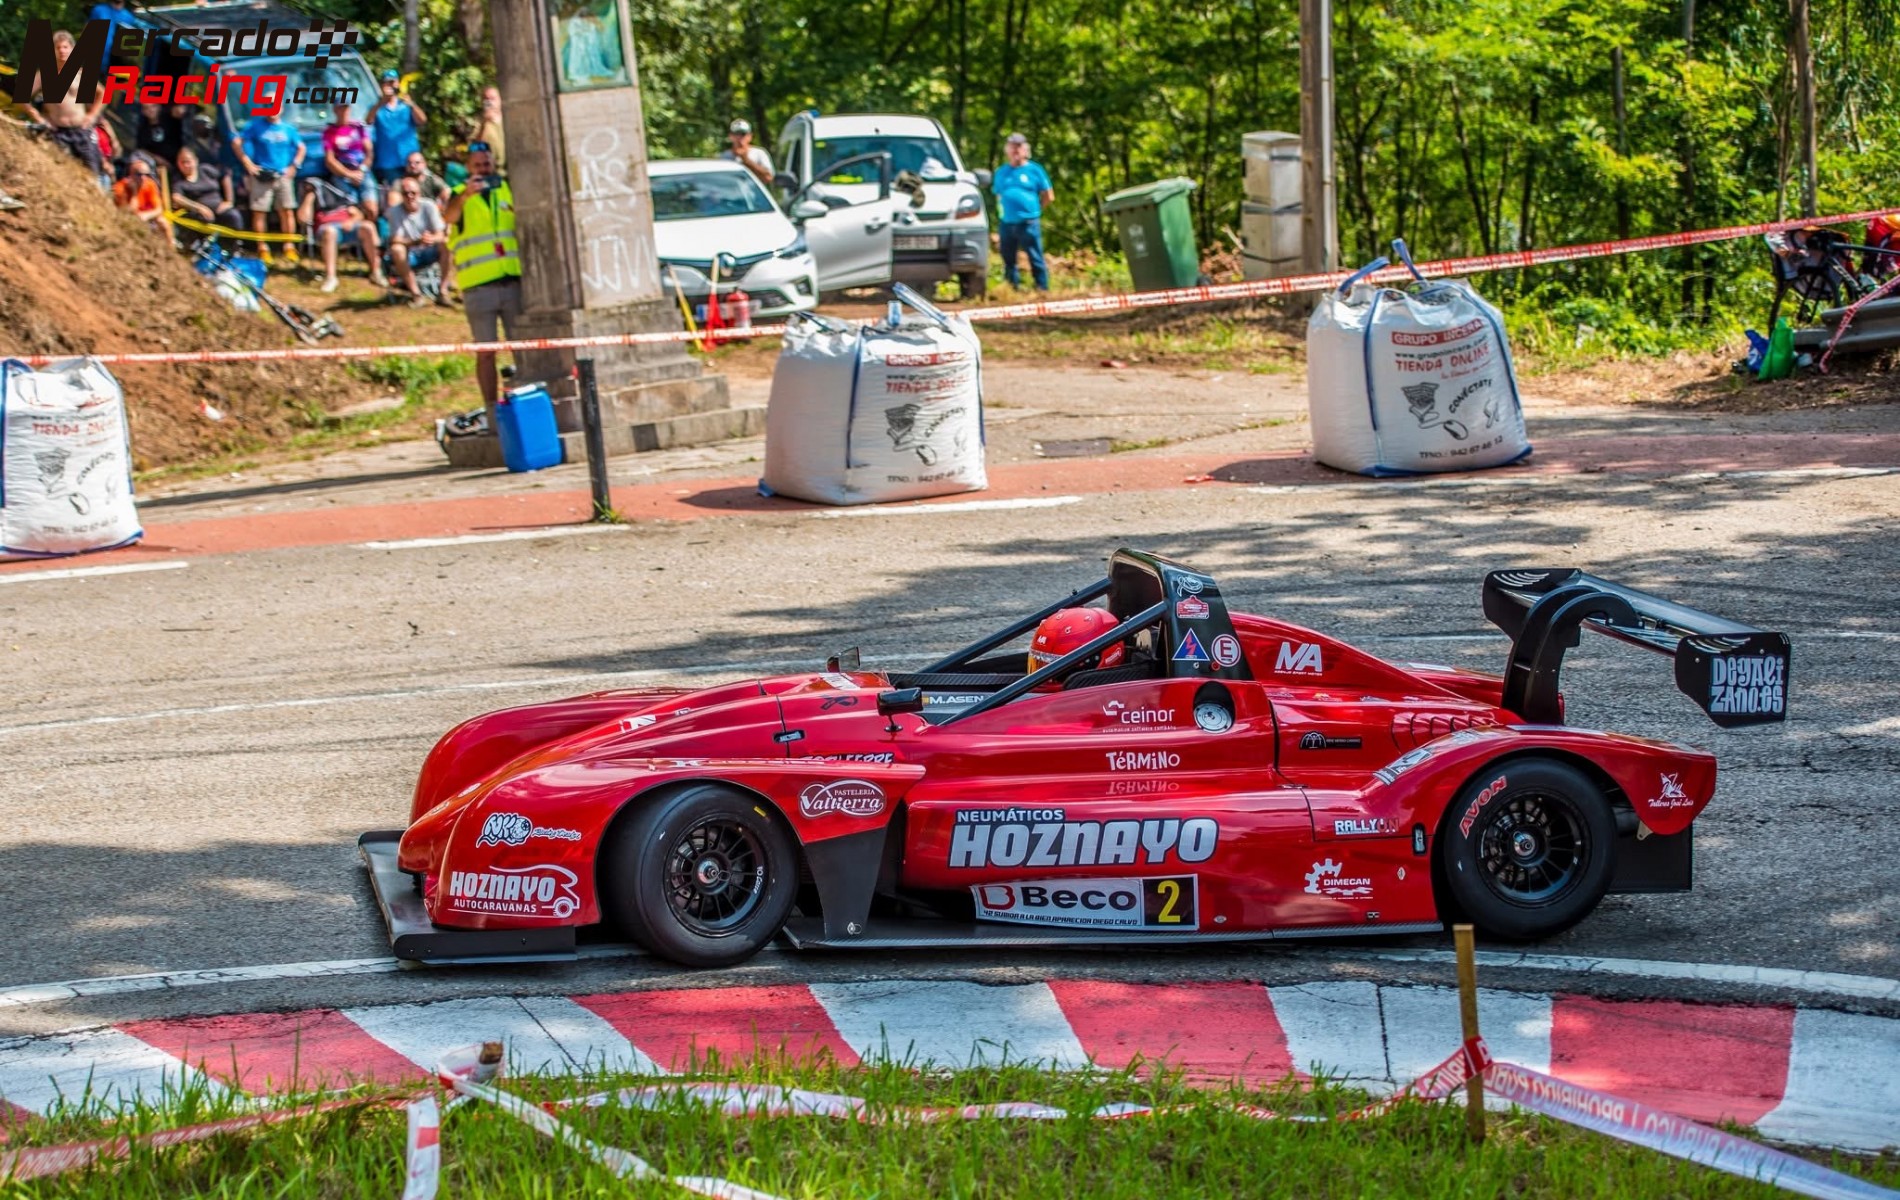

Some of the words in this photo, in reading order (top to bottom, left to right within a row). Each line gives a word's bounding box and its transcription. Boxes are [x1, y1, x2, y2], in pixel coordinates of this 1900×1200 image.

[1394, 332, 1437, 345] GRUPO
[1443, 318, 1482, 341] INCERA
[1395, 359, 1443, 373] TIENDA
[1450, 342, 1490, 368] ONLINE
[1275, 641, 1323, 673] MA
[929, 695, 984, 705] M.ASEN
[1121, 706, 1176, 724] ceinor
[800, 793, 881, 811] Valtierra
[957, 808, 1065, 823] NEUMÁTICOS
[1460, 775, 1508, 840] AVON
[949, 818, 1218, 868] HOZNAYO
[450, 871, 556, 902] HOZNAYO
[1324, 878, 1371, 887] DIMECAN
[453, 898, 537, 913] AUTOCARAVANAS
[1021, 885, 1138, 911] Beco
[1157, 880, 1182, 923] 2
